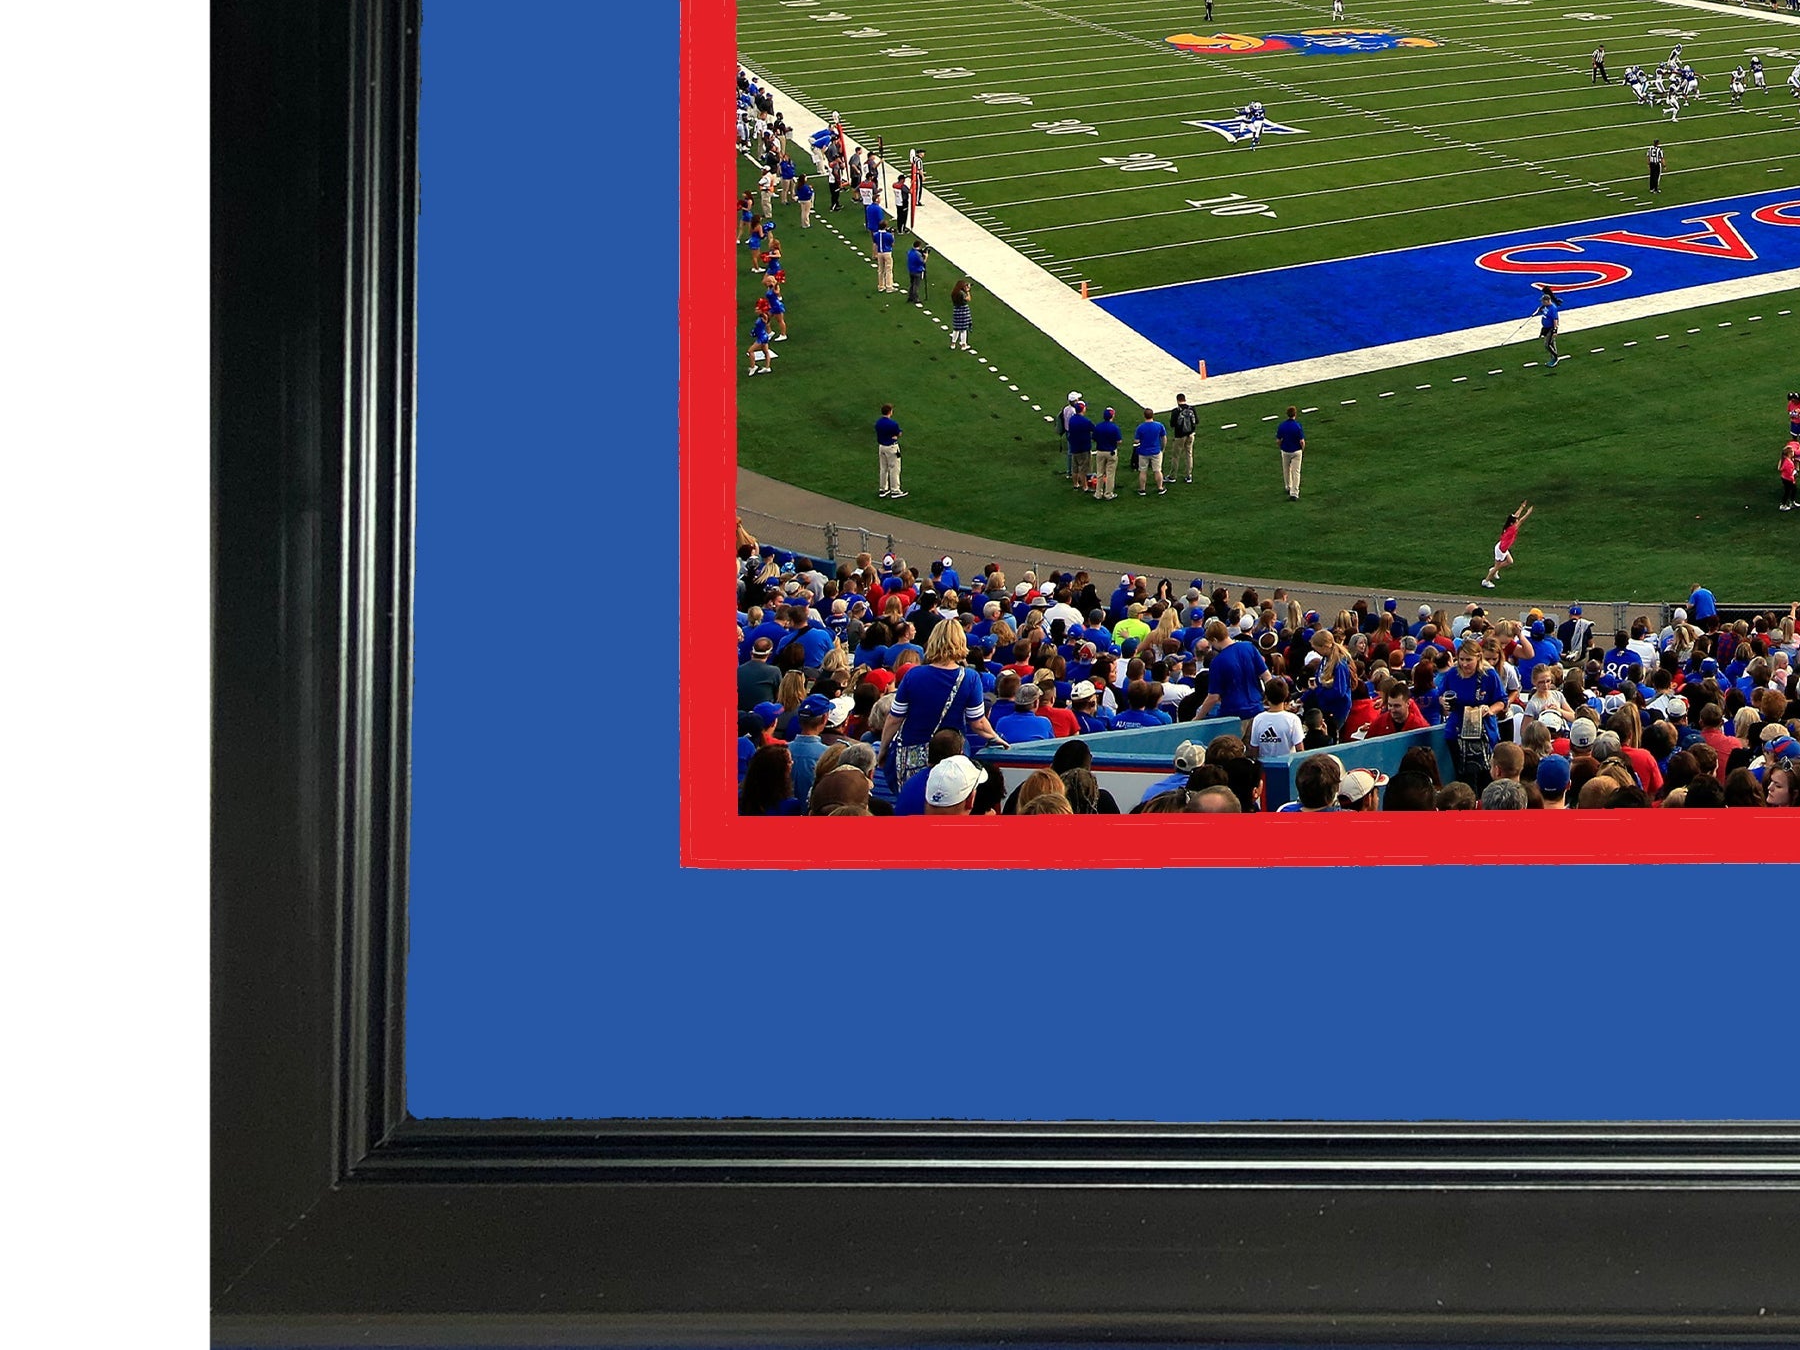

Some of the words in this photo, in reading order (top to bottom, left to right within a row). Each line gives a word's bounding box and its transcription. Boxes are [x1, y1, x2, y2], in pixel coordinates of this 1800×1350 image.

[1031, 118, 1096, 135] 30
[1098, 152, 1174, 173] 20
[1185, 193, 1270, 216] 10
